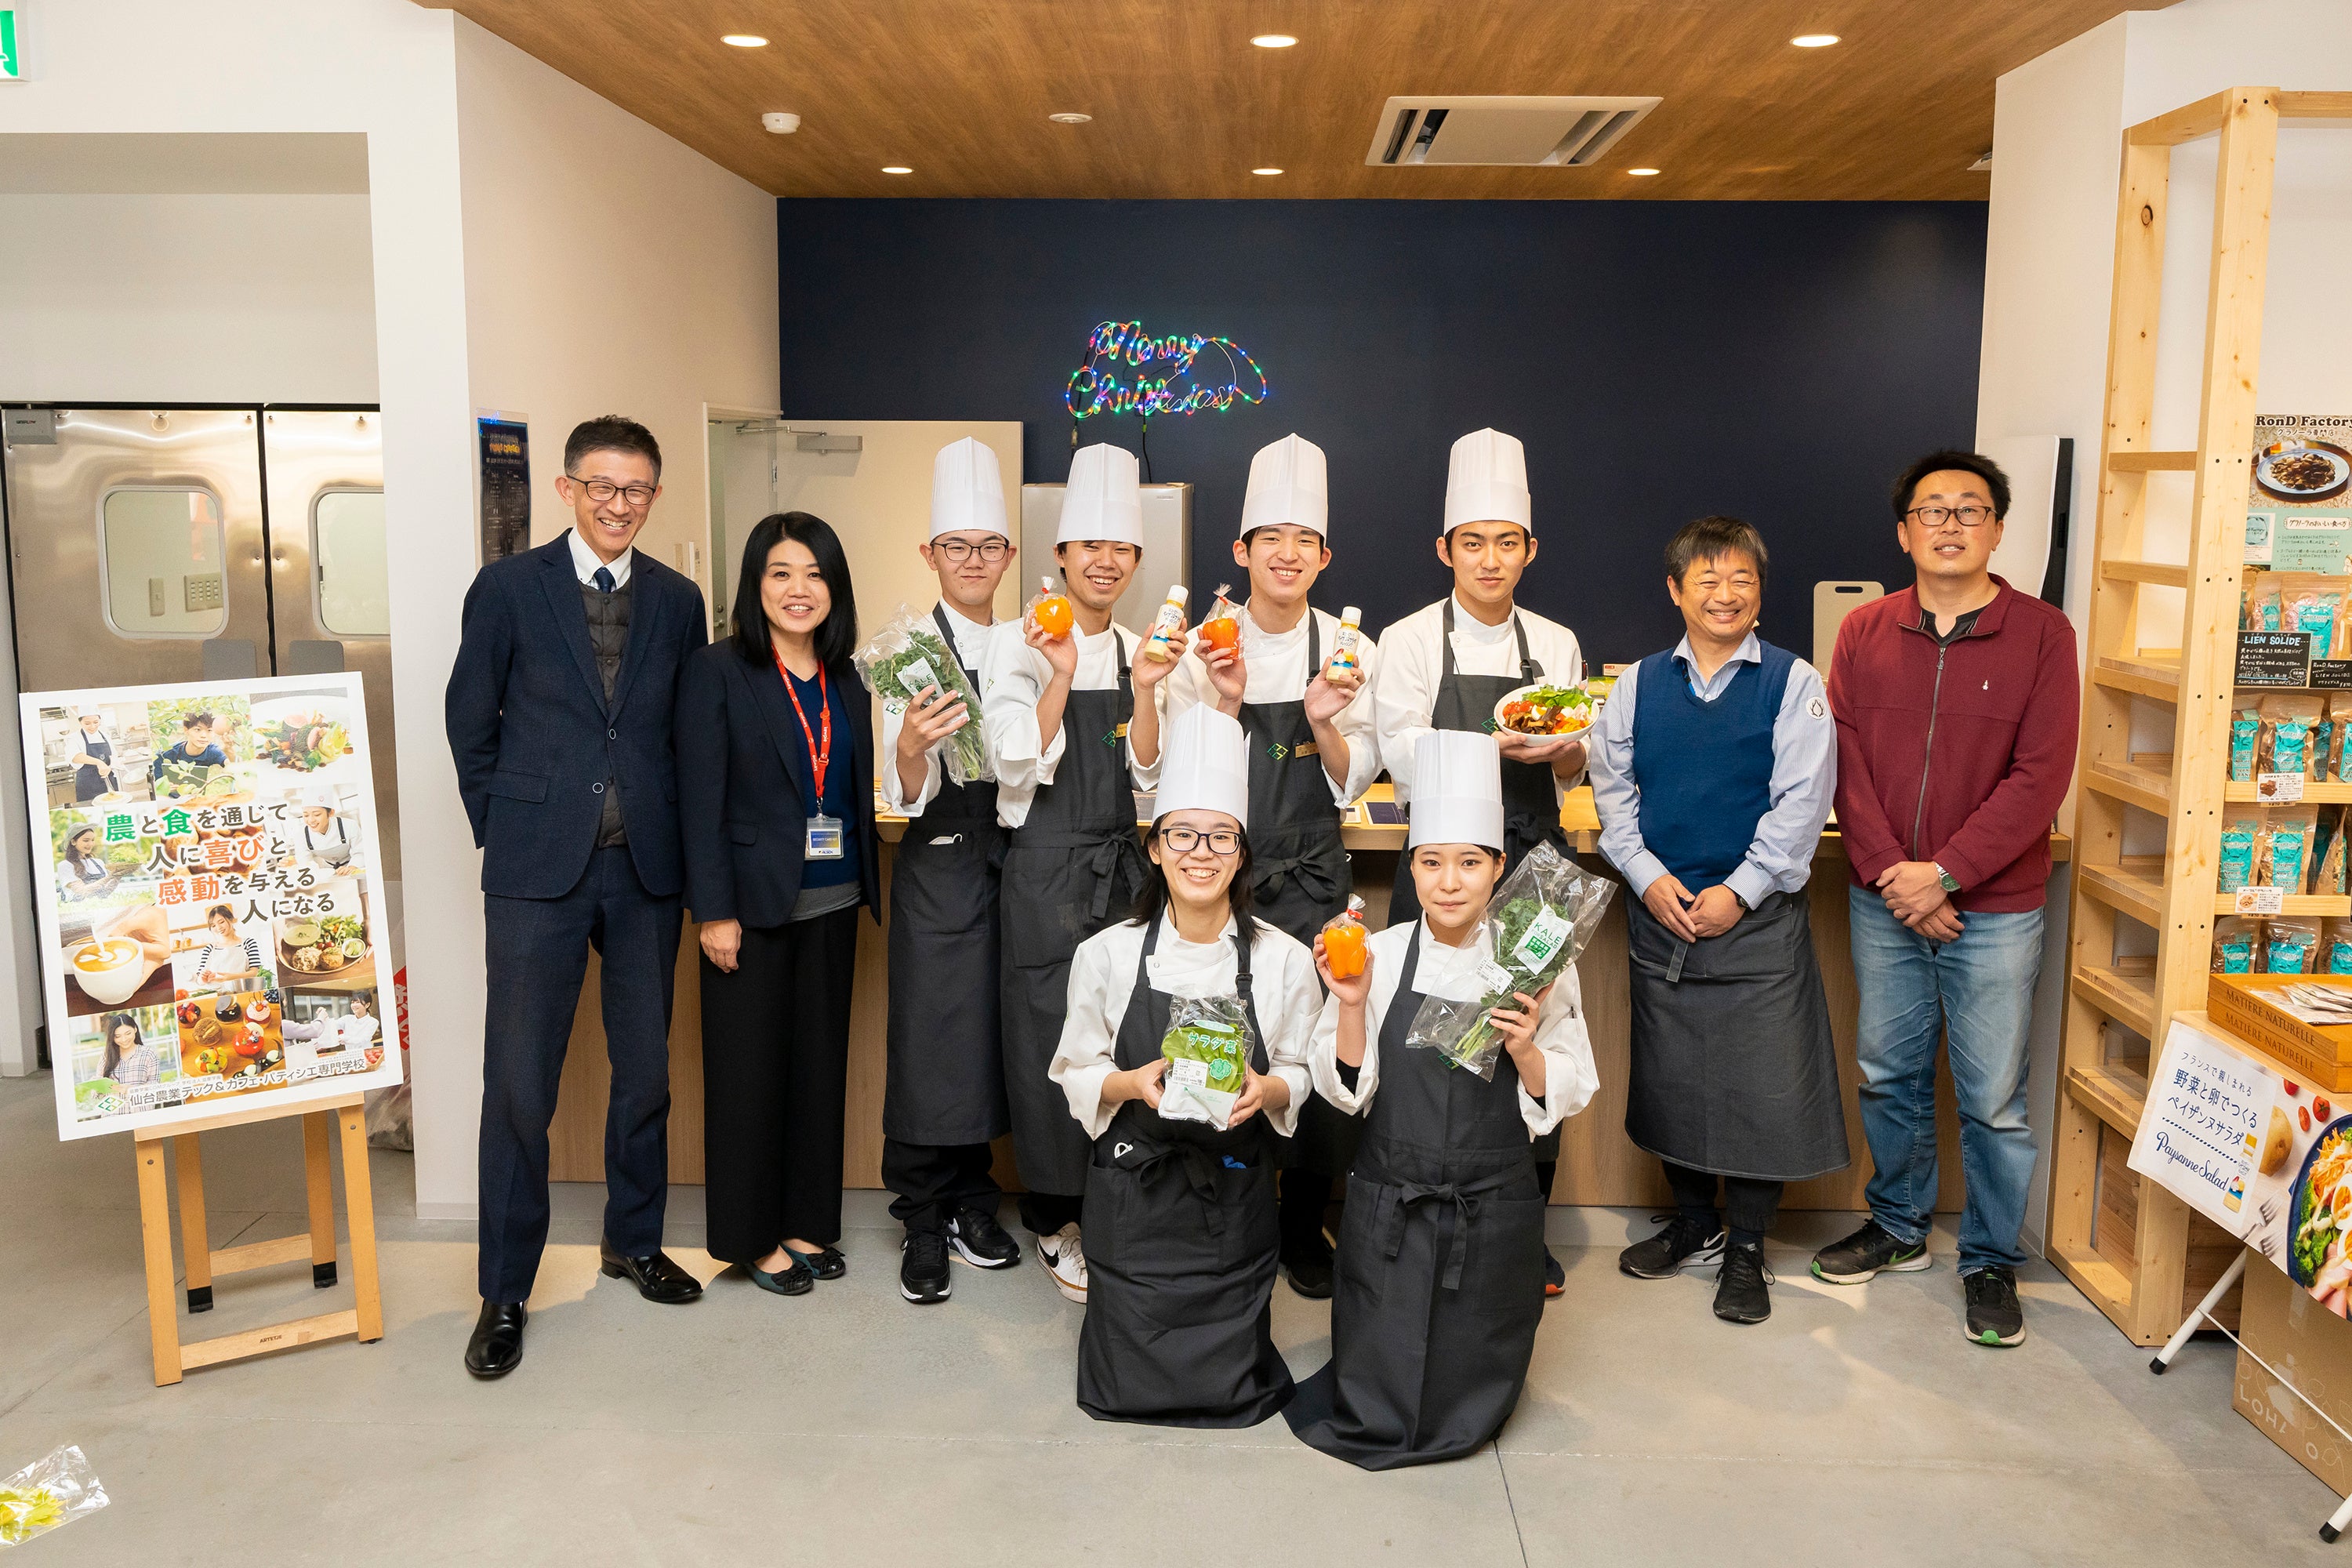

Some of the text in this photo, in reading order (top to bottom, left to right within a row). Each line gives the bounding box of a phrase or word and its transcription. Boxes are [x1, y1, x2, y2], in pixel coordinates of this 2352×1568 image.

[2256, 416, 2296, 426] RonD
[2244, 636, 2302, 646] LIEN SOLIDE
[907, 673, 933, 689] KALE
[105, 803, 289, 842] 農と食を通じて
[146, 834, 287, 872] 人に喜びと
[158, 866, 315, 906] 感動を与える
[241, 892, 335, 924] 人になる
[1534, 922, 1563, 946] KALE
[1189, 1033, 1237, 1054] サラダ菜
[2265, 1011, 2314, 1047] NATURELLE
[2264, 1035, 2314, 1072] NATURELLE
[2181, 1051, 2252, 1097] フランスで親しまれる
[2173, 1068, 2257, 1128] 野菜と卵でつくる
[2167, 1096, 2245, 1146] ペイザンヌサラダ
[2156, 1131, 2199, 1173] Paysanne
[2198, 1160, 2230, 1192] Salad
